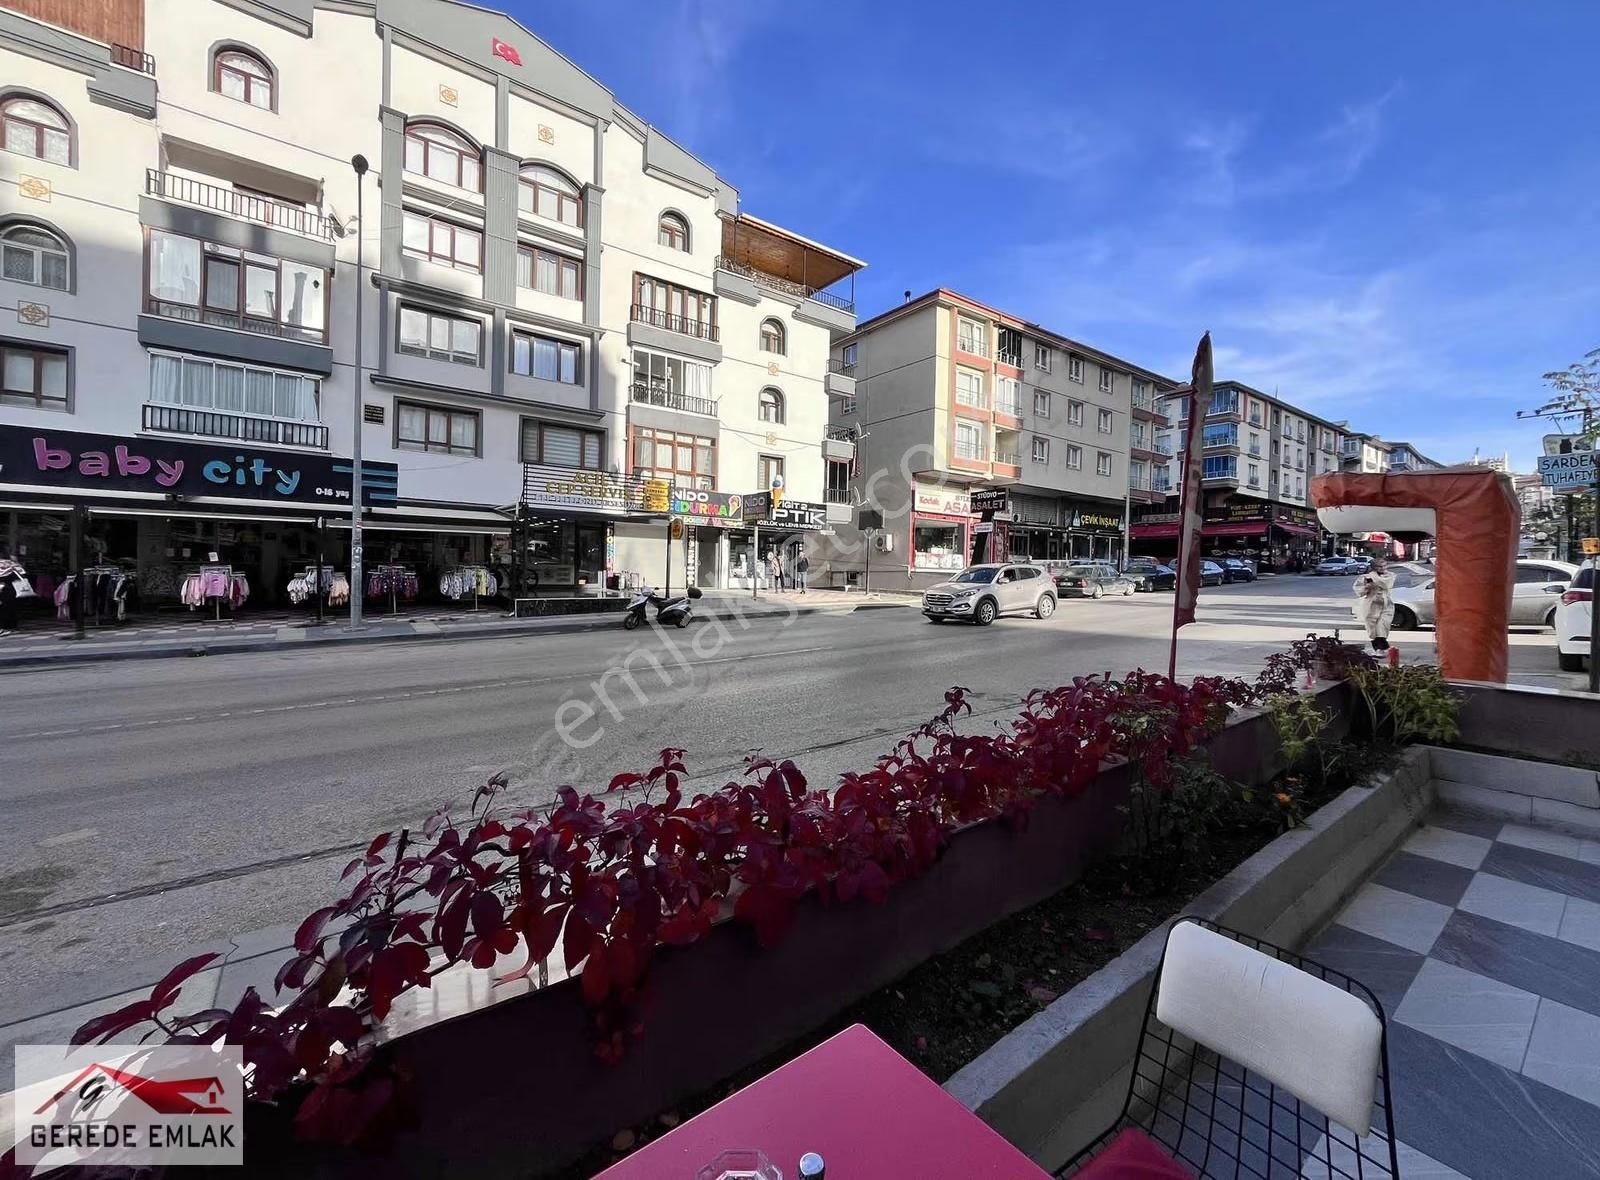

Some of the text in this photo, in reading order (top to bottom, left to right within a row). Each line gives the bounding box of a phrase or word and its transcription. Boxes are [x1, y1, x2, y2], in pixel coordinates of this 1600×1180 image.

[33, 437, 301, 495] baby city
[919, 495, 940, 506] Kodak
[976, 491, 998, 500] STÜDYO
[943, 501, 970, 514] ASA
[971, 499, 1005, 512] ASALET
